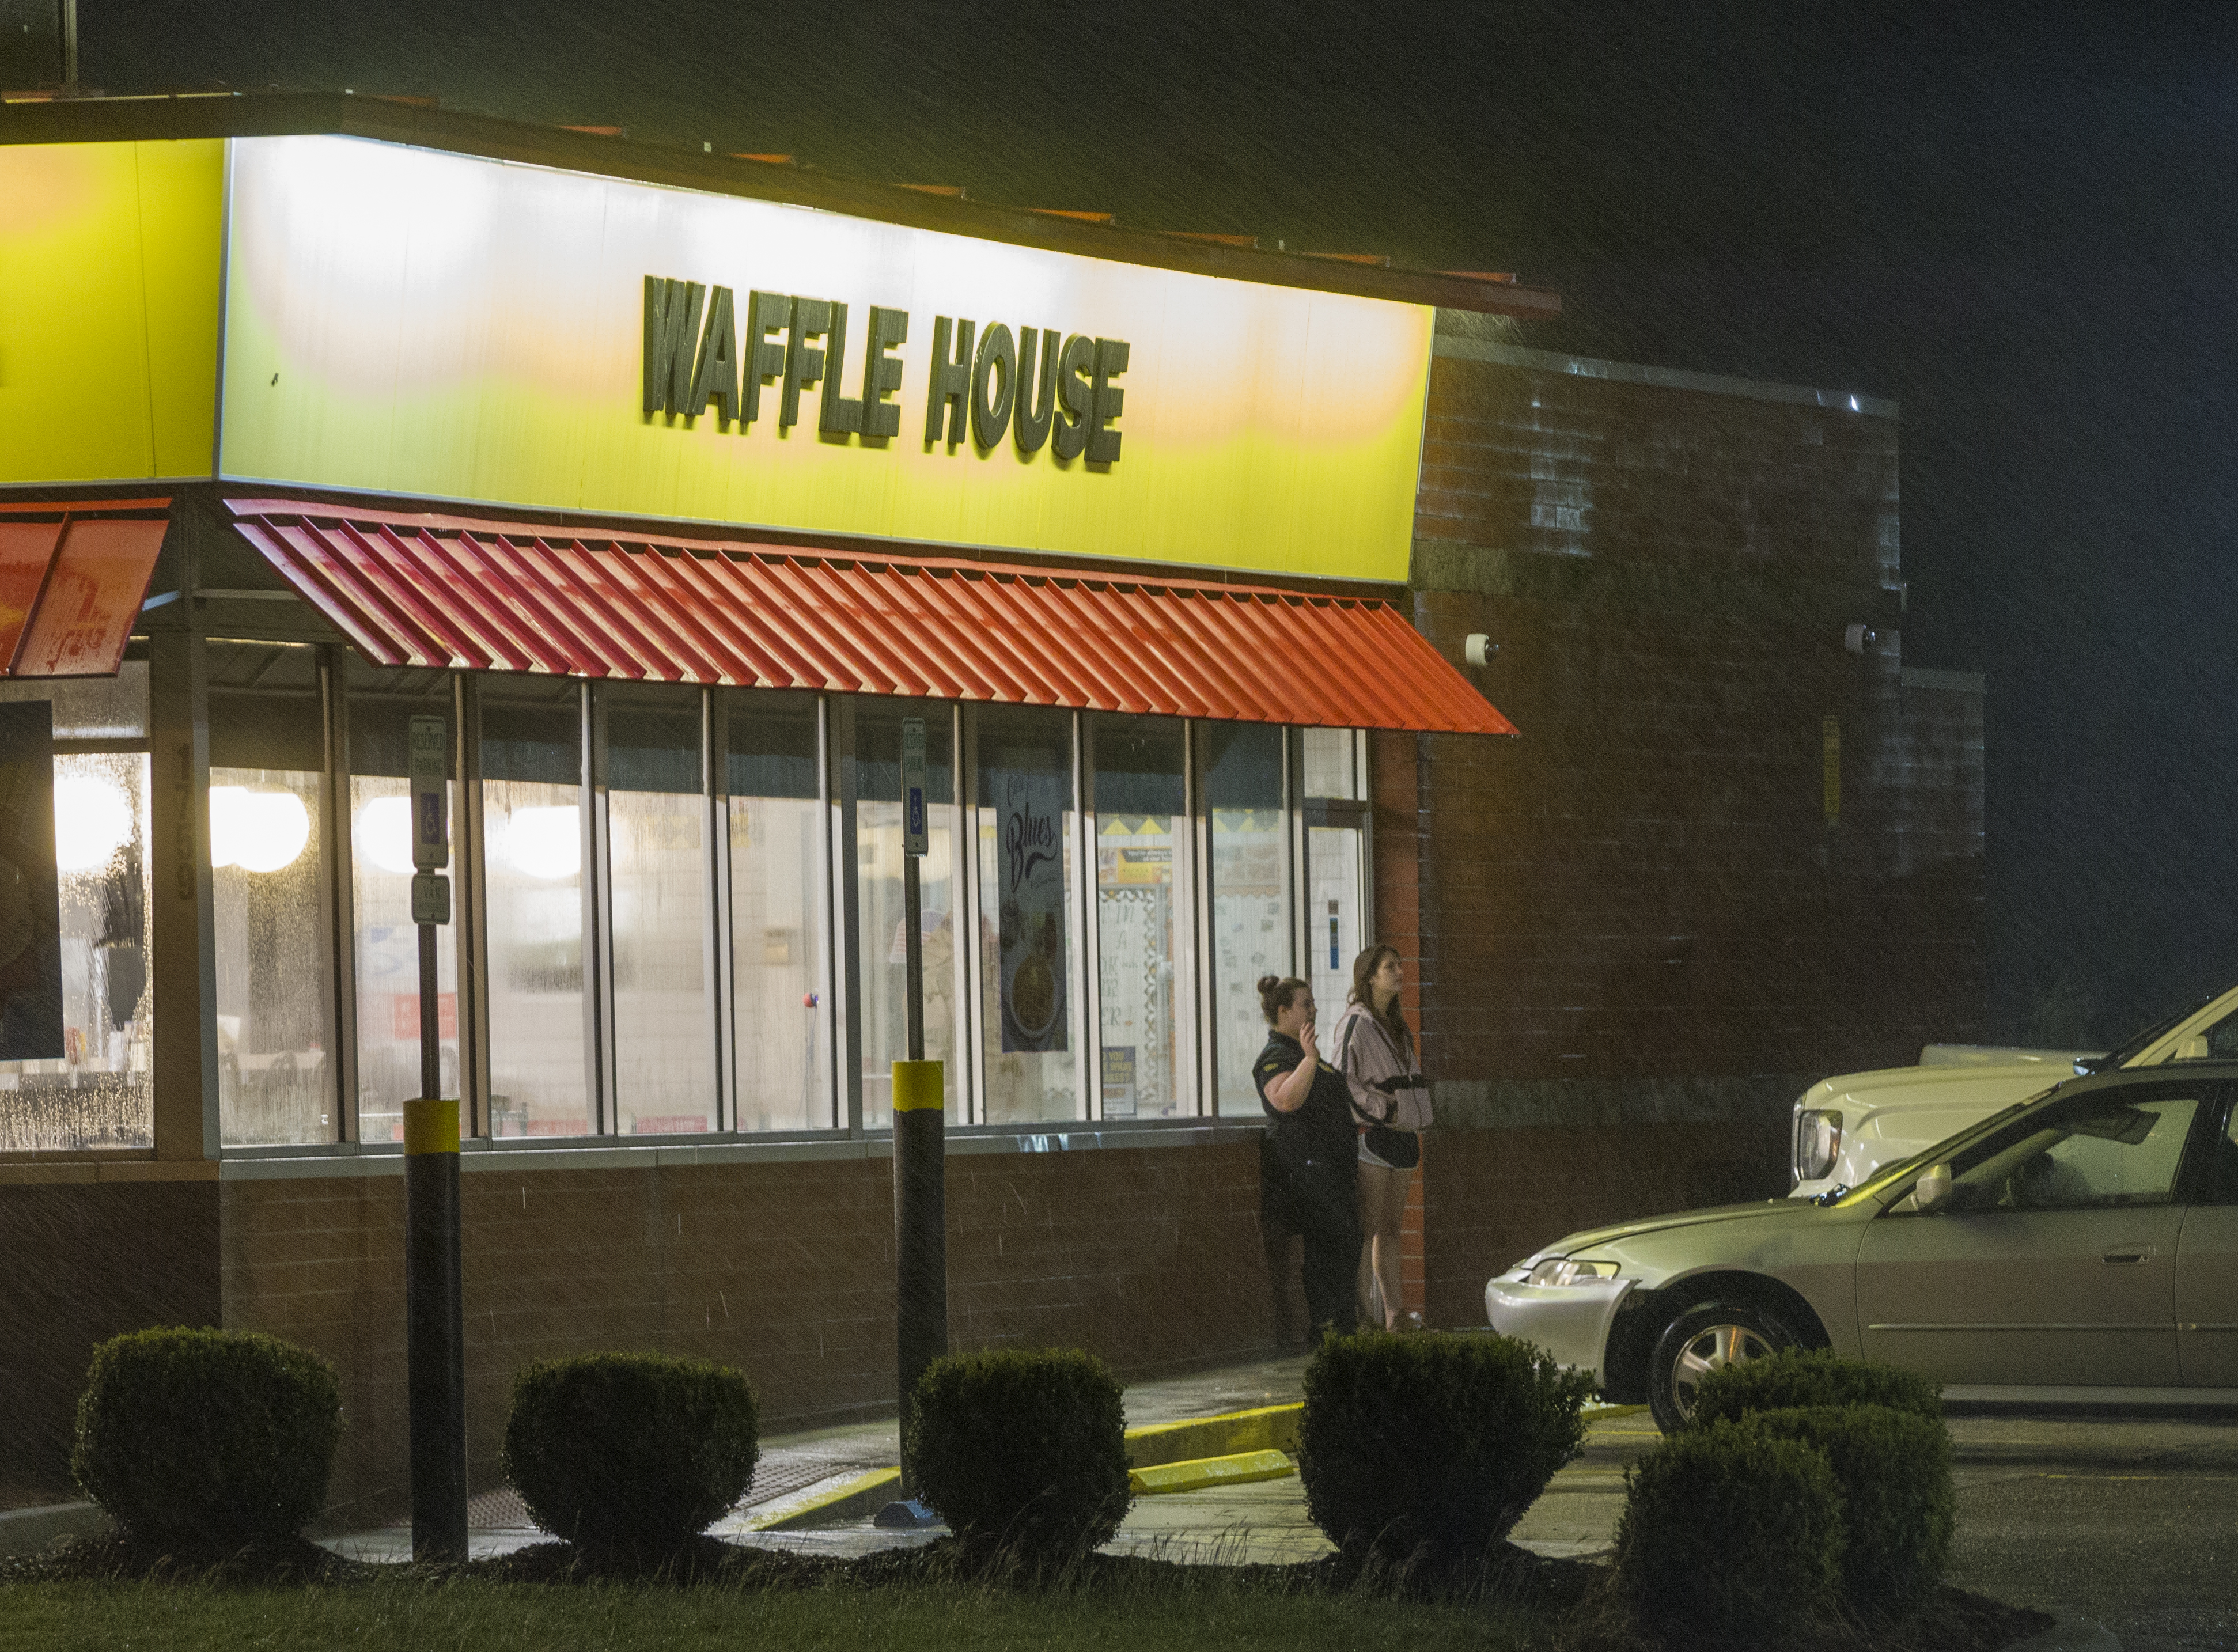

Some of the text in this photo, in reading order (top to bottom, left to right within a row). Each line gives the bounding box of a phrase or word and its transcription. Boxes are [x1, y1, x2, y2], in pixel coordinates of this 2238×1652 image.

[643, 274, 1131, 462] WAFFLE HOUSE
[411, 732, 445, 751] RESERVED
[1006, 801, 1058, 893] Blues
[423, 885, 441, 899] VAN
[1108, 1051, 1124, 1062] YOU
